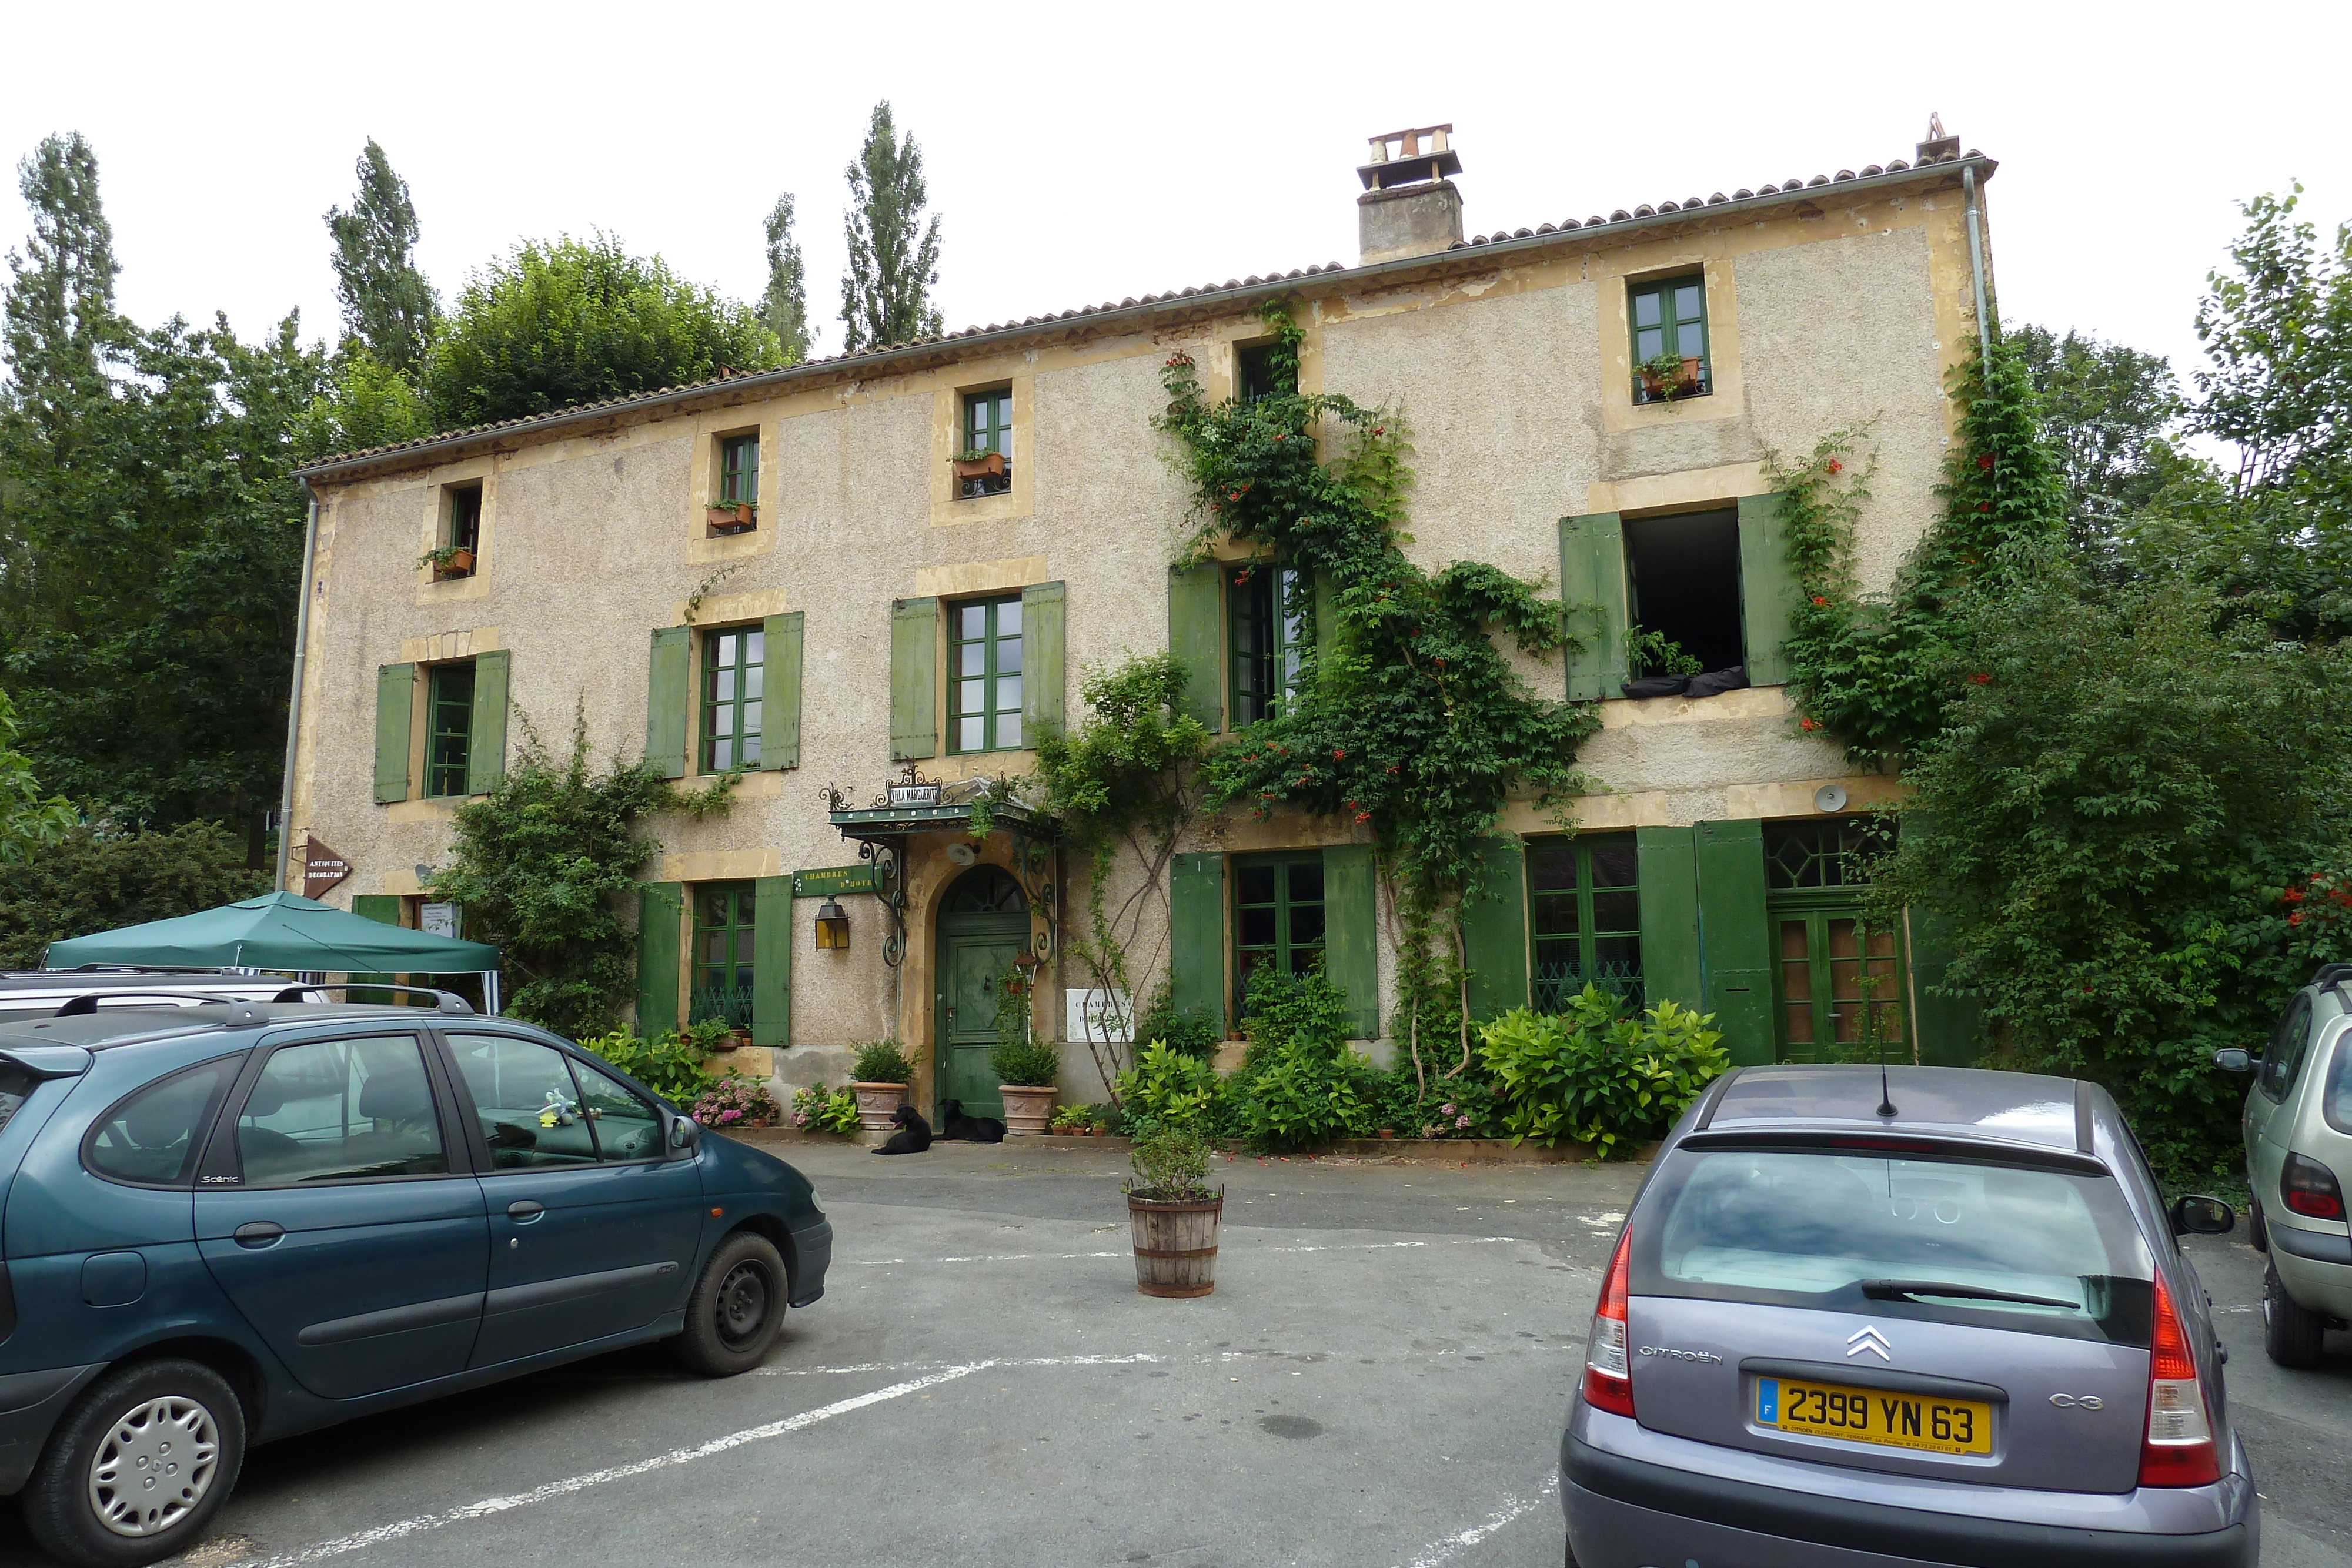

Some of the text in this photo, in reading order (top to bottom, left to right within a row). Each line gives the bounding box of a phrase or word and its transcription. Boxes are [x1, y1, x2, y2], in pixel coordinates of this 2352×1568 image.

[891, 787, 938, 801] VILLA MARGUERITE
[804, 870, 848, 880] CHAMBRES
[1639, 1345, 1723, 1365] CITROËN
[2049, 1393, 2104, 1410] C3
[1764, 1387, 1973, 1443] F 2399 YN 63
